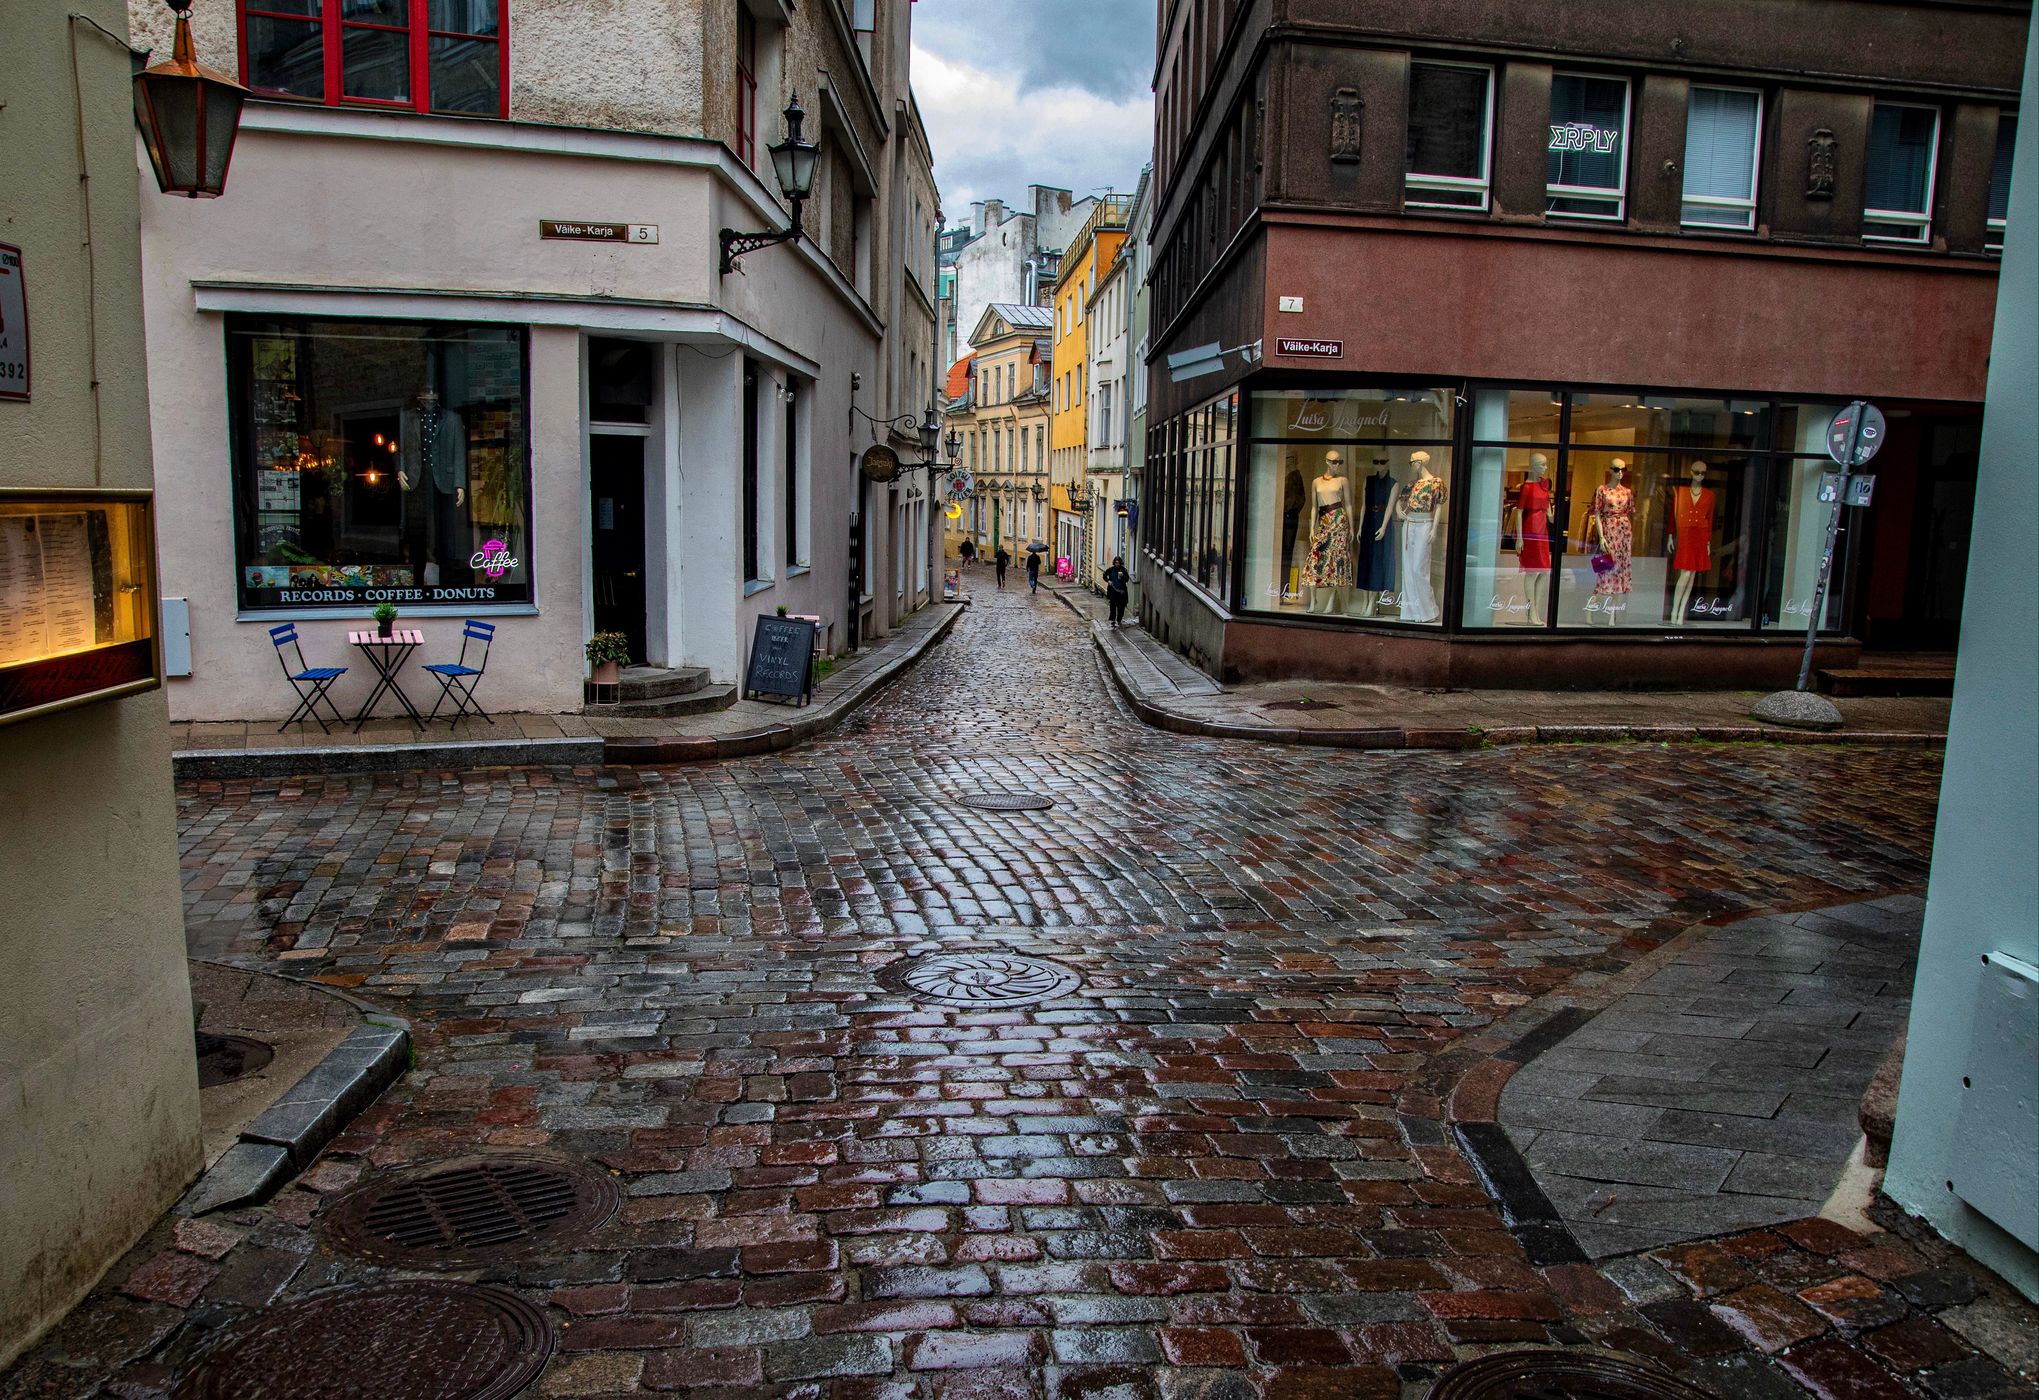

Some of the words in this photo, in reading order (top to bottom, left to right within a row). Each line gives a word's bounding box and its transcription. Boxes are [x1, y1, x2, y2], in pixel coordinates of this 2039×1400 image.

[639, 228, 648, 240] 5
[1288, 299, 1295, 309] 7
[1282, 341, 1338, 354] Väike-Karja
[1288, 399, 1330, 432] Luisa
[947, 487, 973, 500] KELLER
[470, 551, 519, 573] Coffee
[280, 590, 355, 602] RECORDS
[365, 589, 423, 601] COFFEE
[433, 587, 495, 600] DONUTS
[764, 624, 801, 635] COFFEE
[760, 653, 789, 666] VINYL
[755, 665, 799, 681] RECORDS
